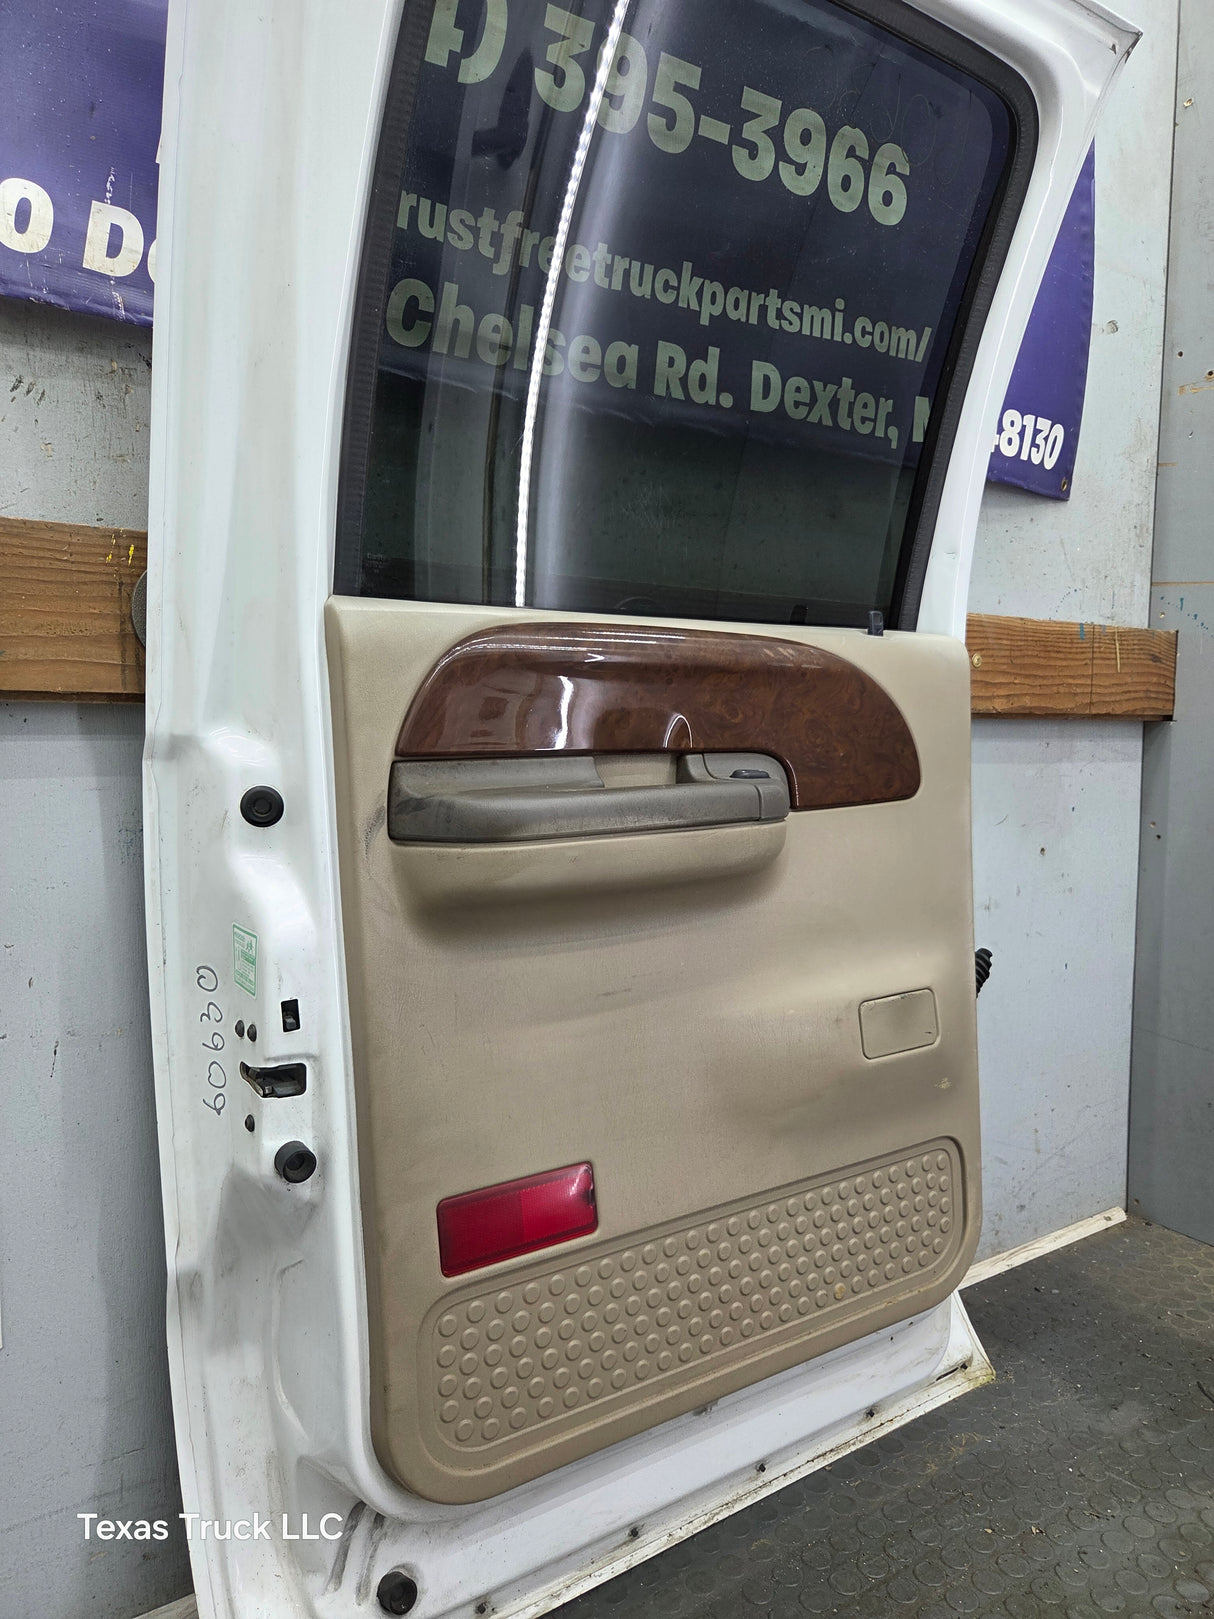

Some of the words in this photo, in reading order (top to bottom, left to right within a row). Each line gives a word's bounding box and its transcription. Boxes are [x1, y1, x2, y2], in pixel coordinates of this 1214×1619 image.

[534, 3, 911, 226] 395-3966
[386, 278, 639, 390] Chelsea
[653, 341, 734, 409] Rd.
[750, 360, 899, 449] Dexter,
[196, 965, 227, 1116] 60630
